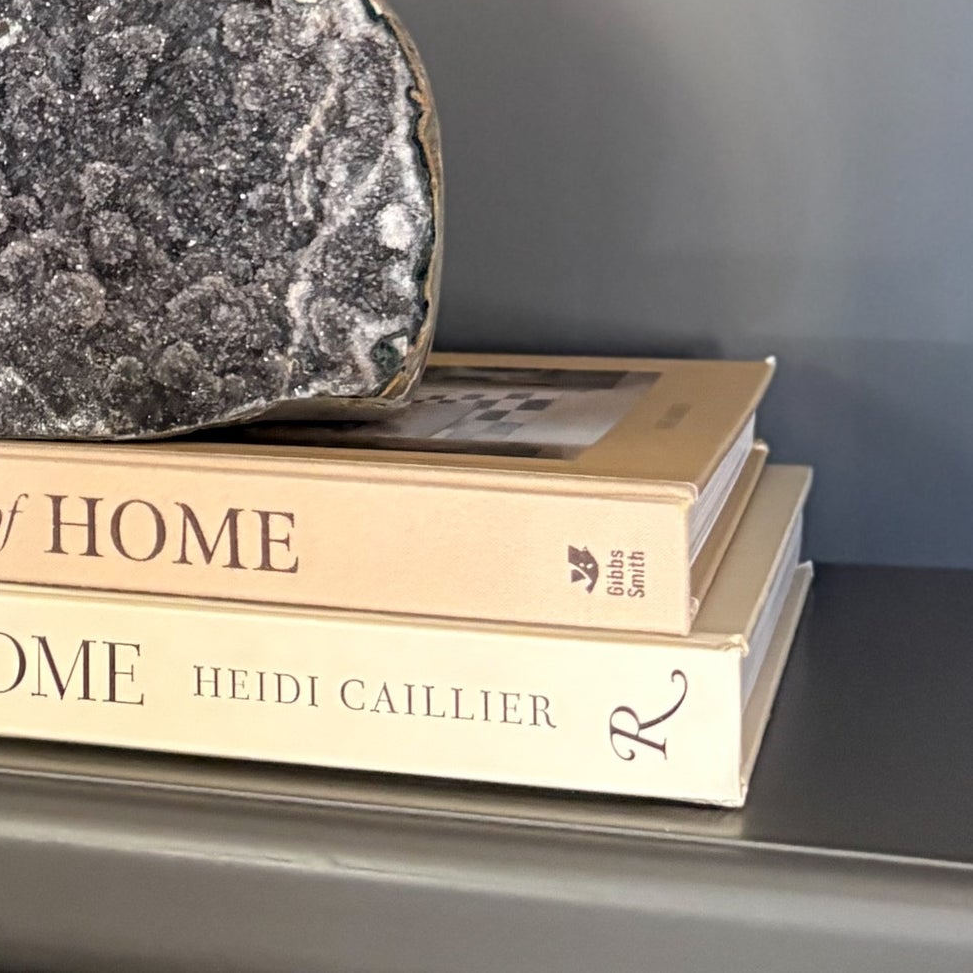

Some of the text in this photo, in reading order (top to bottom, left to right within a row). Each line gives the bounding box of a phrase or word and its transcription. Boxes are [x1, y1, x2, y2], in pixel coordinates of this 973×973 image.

[43, 493, 299, 574] HOME
[606, 549, 625, 597] Gibbs
[626, 550, 646, 599] Smith
[192, 664, 558, 729] HEIDI CAILLIER
